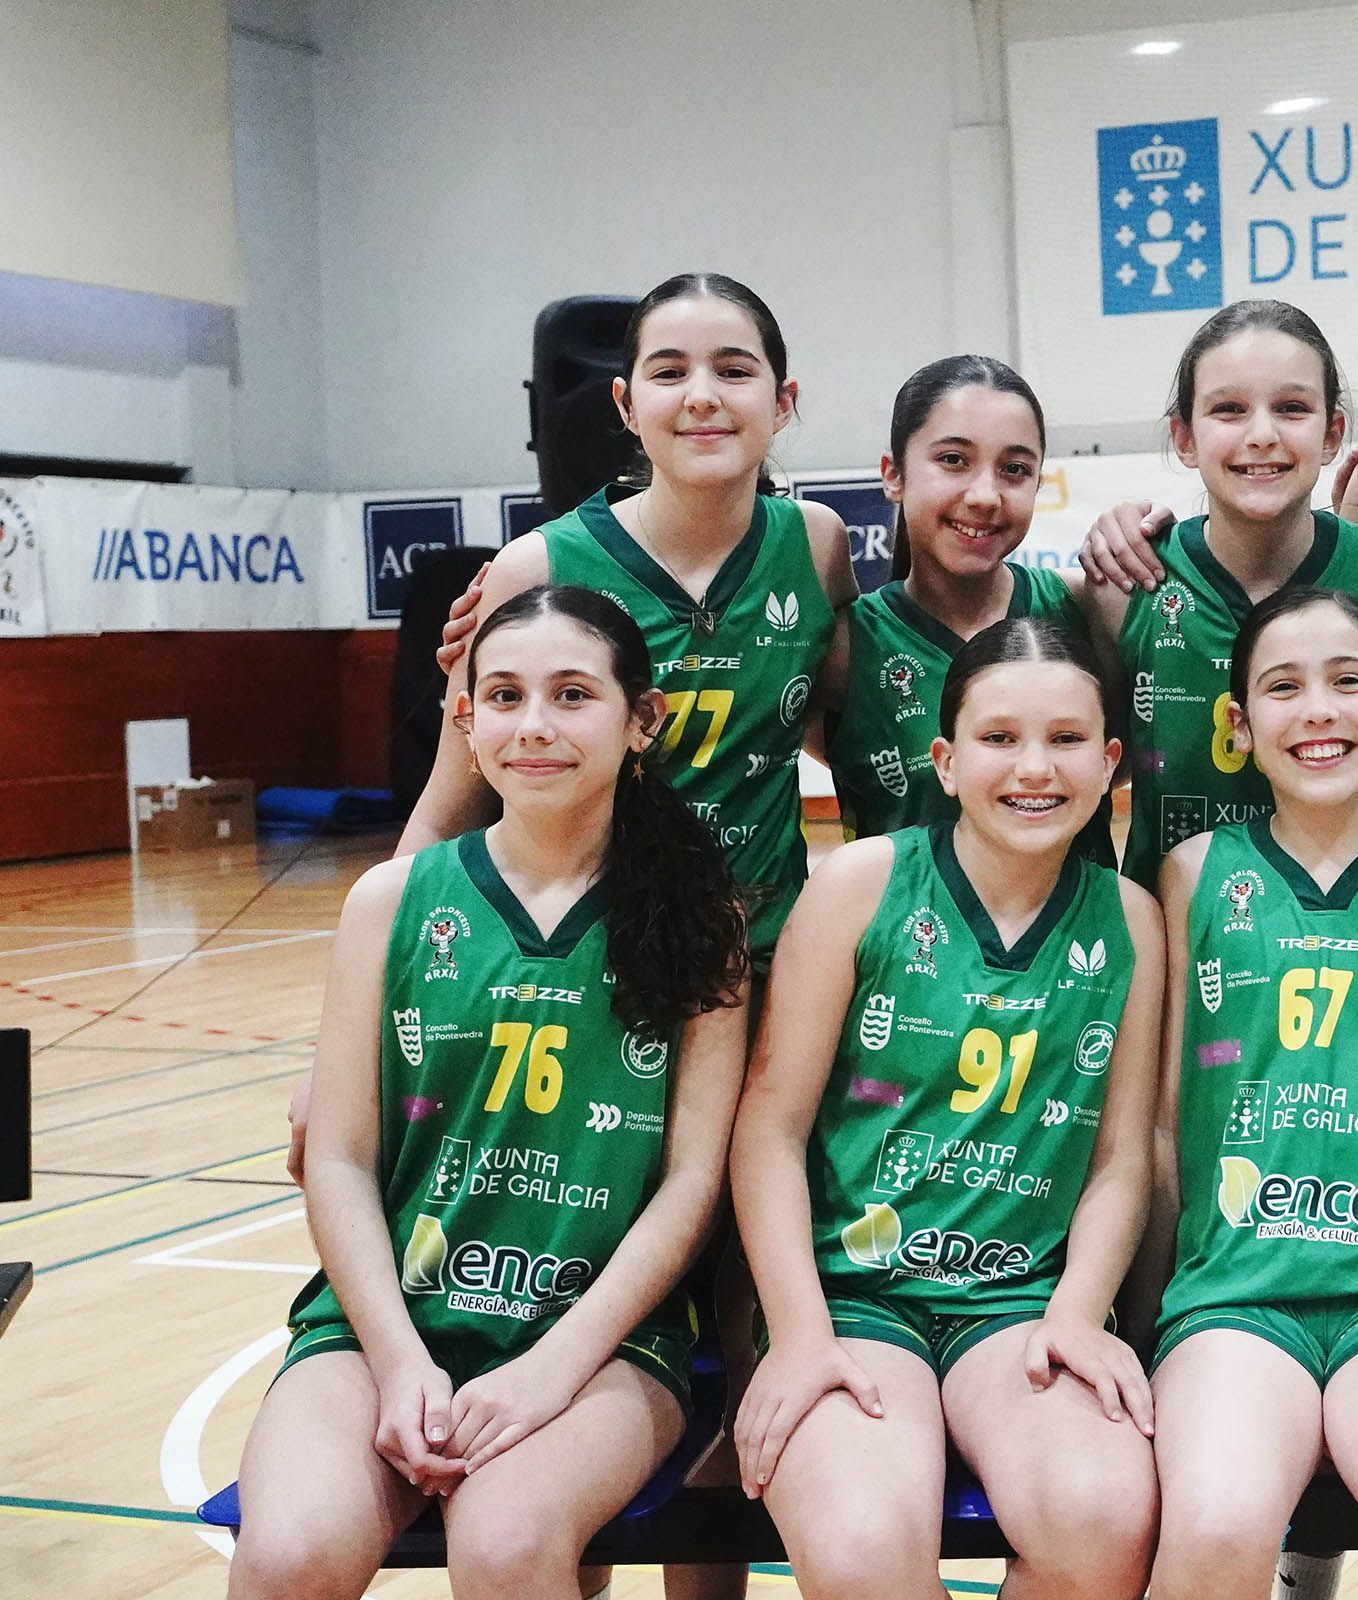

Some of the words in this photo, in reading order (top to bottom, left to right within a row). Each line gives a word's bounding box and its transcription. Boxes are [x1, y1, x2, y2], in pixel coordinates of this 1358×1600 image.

[1248, 213, 1348, 284] DE
[846, 524, 894, 562] CR
[379, 542, 448, 580] AC
[756, 636, 773, 647] LF
[1154, 638, 1186, 650] ARXIL
[883, 653, 926, 678] BALONCESTO
[879, 669, 888, 689] CLUB
[1154, 685, 1186, 694] Concello
[1165, 694, 1206, 704] Pontevedra
[895, 706, 927, 722] ARXIL
[429, 905, 471, 938] BALONCESTO
[903, 915, 915, 934] CLUB
[1223, 921, 1255, 935] ARXIL
[424, 968, 460, 983] ARXIL
[905, 963, 938, 980] ARXIL
[1058, 979, 1075, 989] LF
[1278, 966, 1354, 1051] 67
[898, 1014, 933, 1026] Concello
[908, 1024, 954, 1038] Pontevedra
[483, 1022, 570, 1115] 76
[950, 1027, 1039, 1115] 91
[1275, 1083, 1348, 1108] XUNTA
[626, 1111, 665, 1123] Deputac
[1272, 1108, 1297, 1130] DE
[475, 1147, 560, 1177] XUNTA
[936, 1139, 1018, 1167] XUNTA
[926, 1162, 957, 1184] DE
[963, 1166, 1053, 1199] GALICIA
[468, 1174, 502, 1195] DE
[507, 1174, 610, 1210] GALICIA
[1259, 1220, 1305, 1237] ENERGÍA
[1307, 1227, 1317, 1239] &
[897, 1227, 1033, 1280] ence
[450, 1239, 593, 1301] ence
[949, 1274, 958, 1283] &
[450, 1292, 507, 1314] ENERGÍA
[510, 1302, 520, 1315] &
